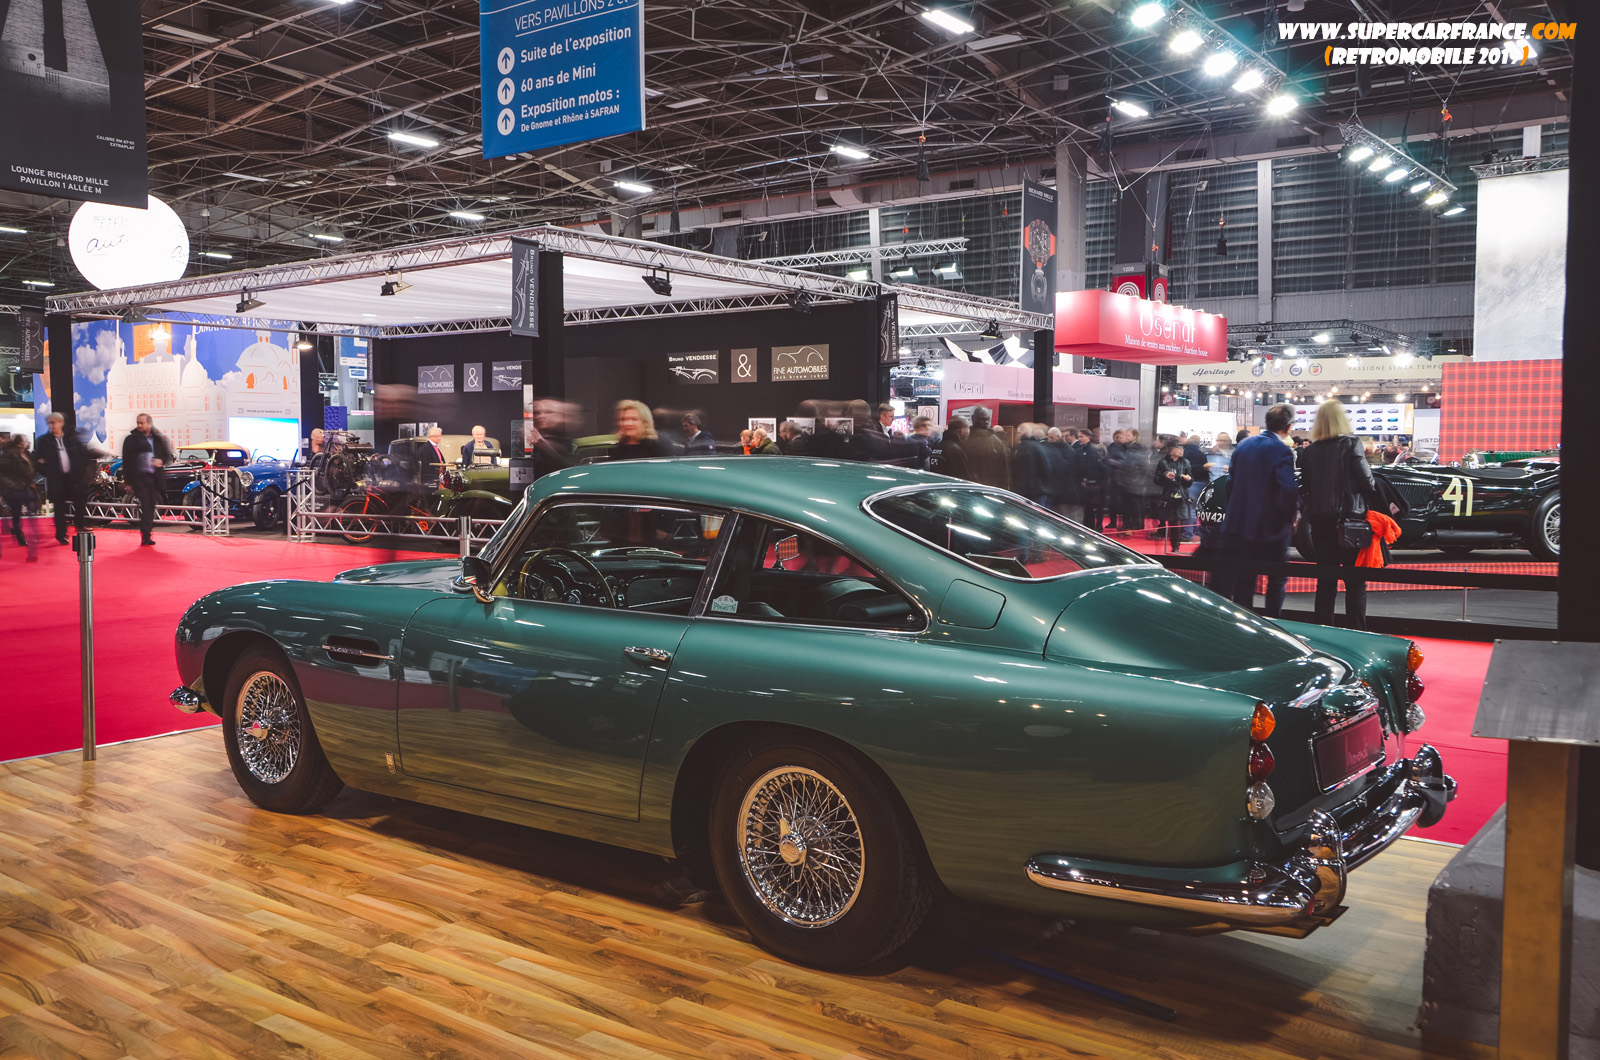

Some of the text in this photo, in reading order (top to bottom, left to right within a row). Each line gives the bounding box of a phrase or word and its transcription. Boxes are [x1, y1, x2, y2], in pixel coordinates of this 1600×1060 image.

[514, 12, 542, 31] VERS
[544, 0, 604, 24] PAVILLONS
[520, 26, 632, 63] Suite de l'exposition
[521, 63, 596, 92] 60 ans de Mini
[521, 96, 576, 118] Exposition
[578, 89, 613, 106] motos
[521, 104, 620, 132] De Gnome et Rhône à SAFRAN
[96, 134, 116, 142] CALIBRE
[110, 142, 134, 150] EXTRAPLAT
[11, 165, 110, 186] LOUNGE RICHARD MILLE
[20, 176, 60, 188] PAVILLON
[68, 183, 94, 193] ALLÉE
[1125, 334, 1140, 346] Maison
[1140, 338, 1146, 347] de
[737, 353, 752, 378] &
[774, 365, 828, 375] FINE AUTOMOBILES
[1192, 368, 1235, 376] Heritage
[468, 367, 479, 387] &
[1442, 477, 1474, 516] 41
